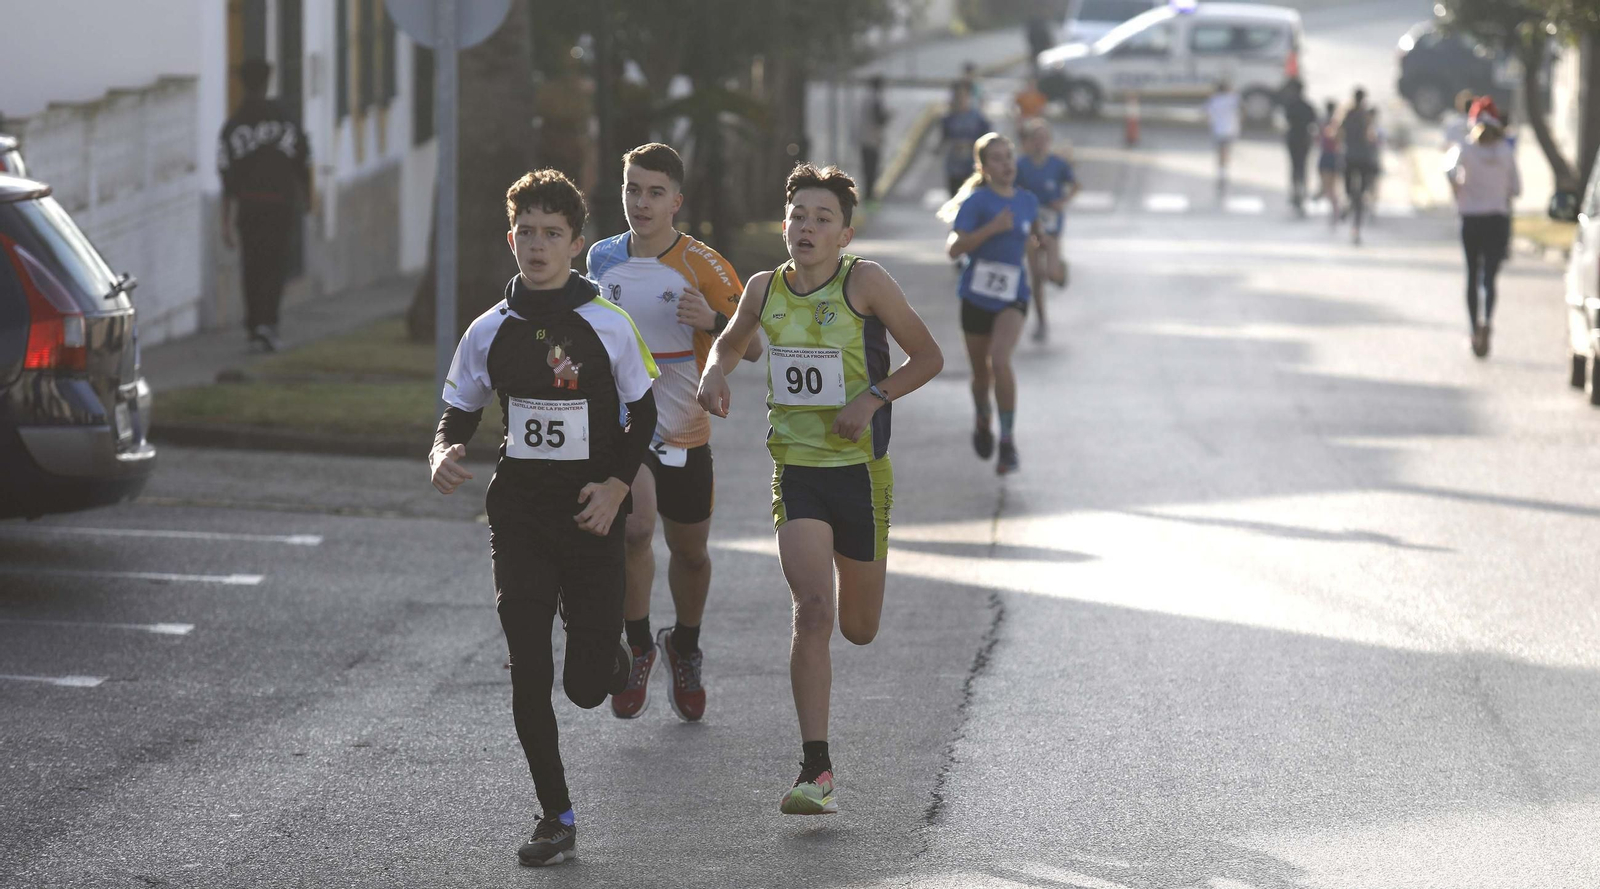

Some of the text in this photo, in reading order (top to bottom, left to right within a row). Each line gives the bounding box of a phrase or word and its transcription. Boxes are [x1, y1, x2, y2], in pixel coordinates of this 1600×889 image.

[785, 366, 823, 395] 90
[511, 402, 537, 410] CASTELLAR
[523, 418, 566, 449] 85
